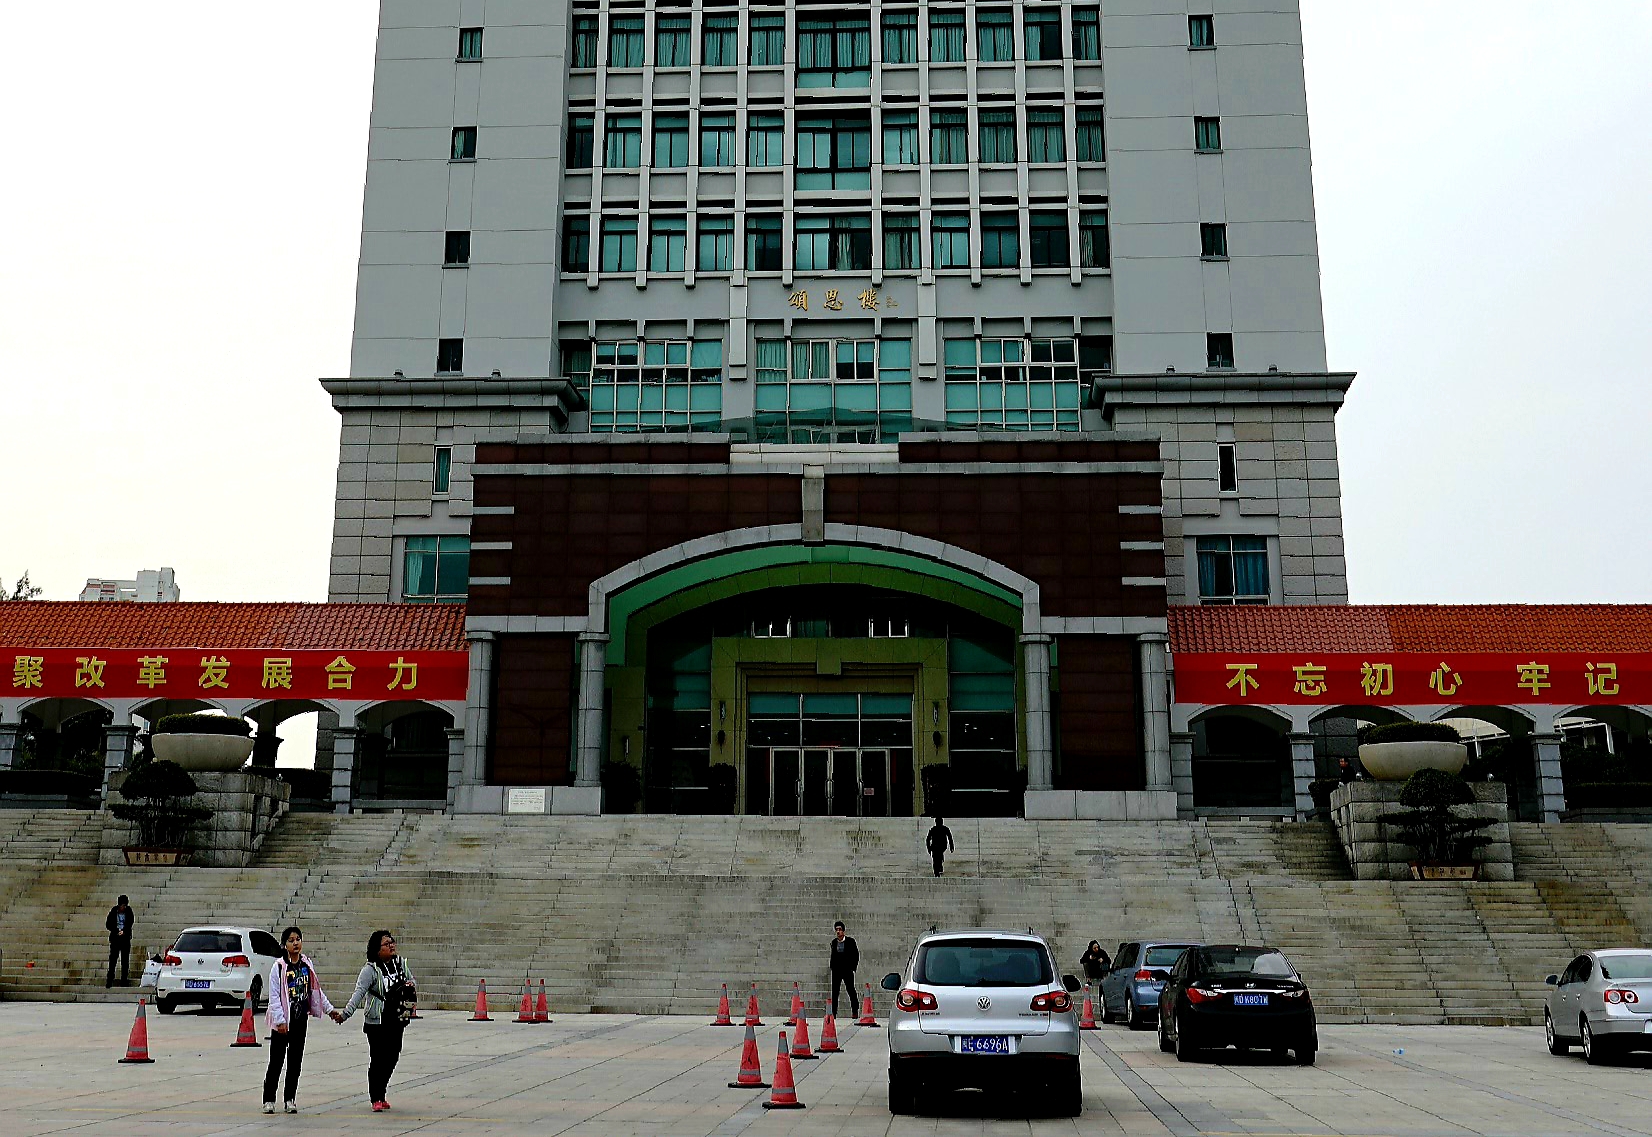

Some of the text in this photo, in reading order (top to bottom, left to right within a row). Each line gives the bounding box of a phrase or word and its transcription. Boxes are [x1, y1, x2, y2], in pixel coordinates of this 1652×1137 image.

[13, 655, 418, 690] 聚改革发展合力
[1226, 661, 1620, 697] 不忘初心 牢记
